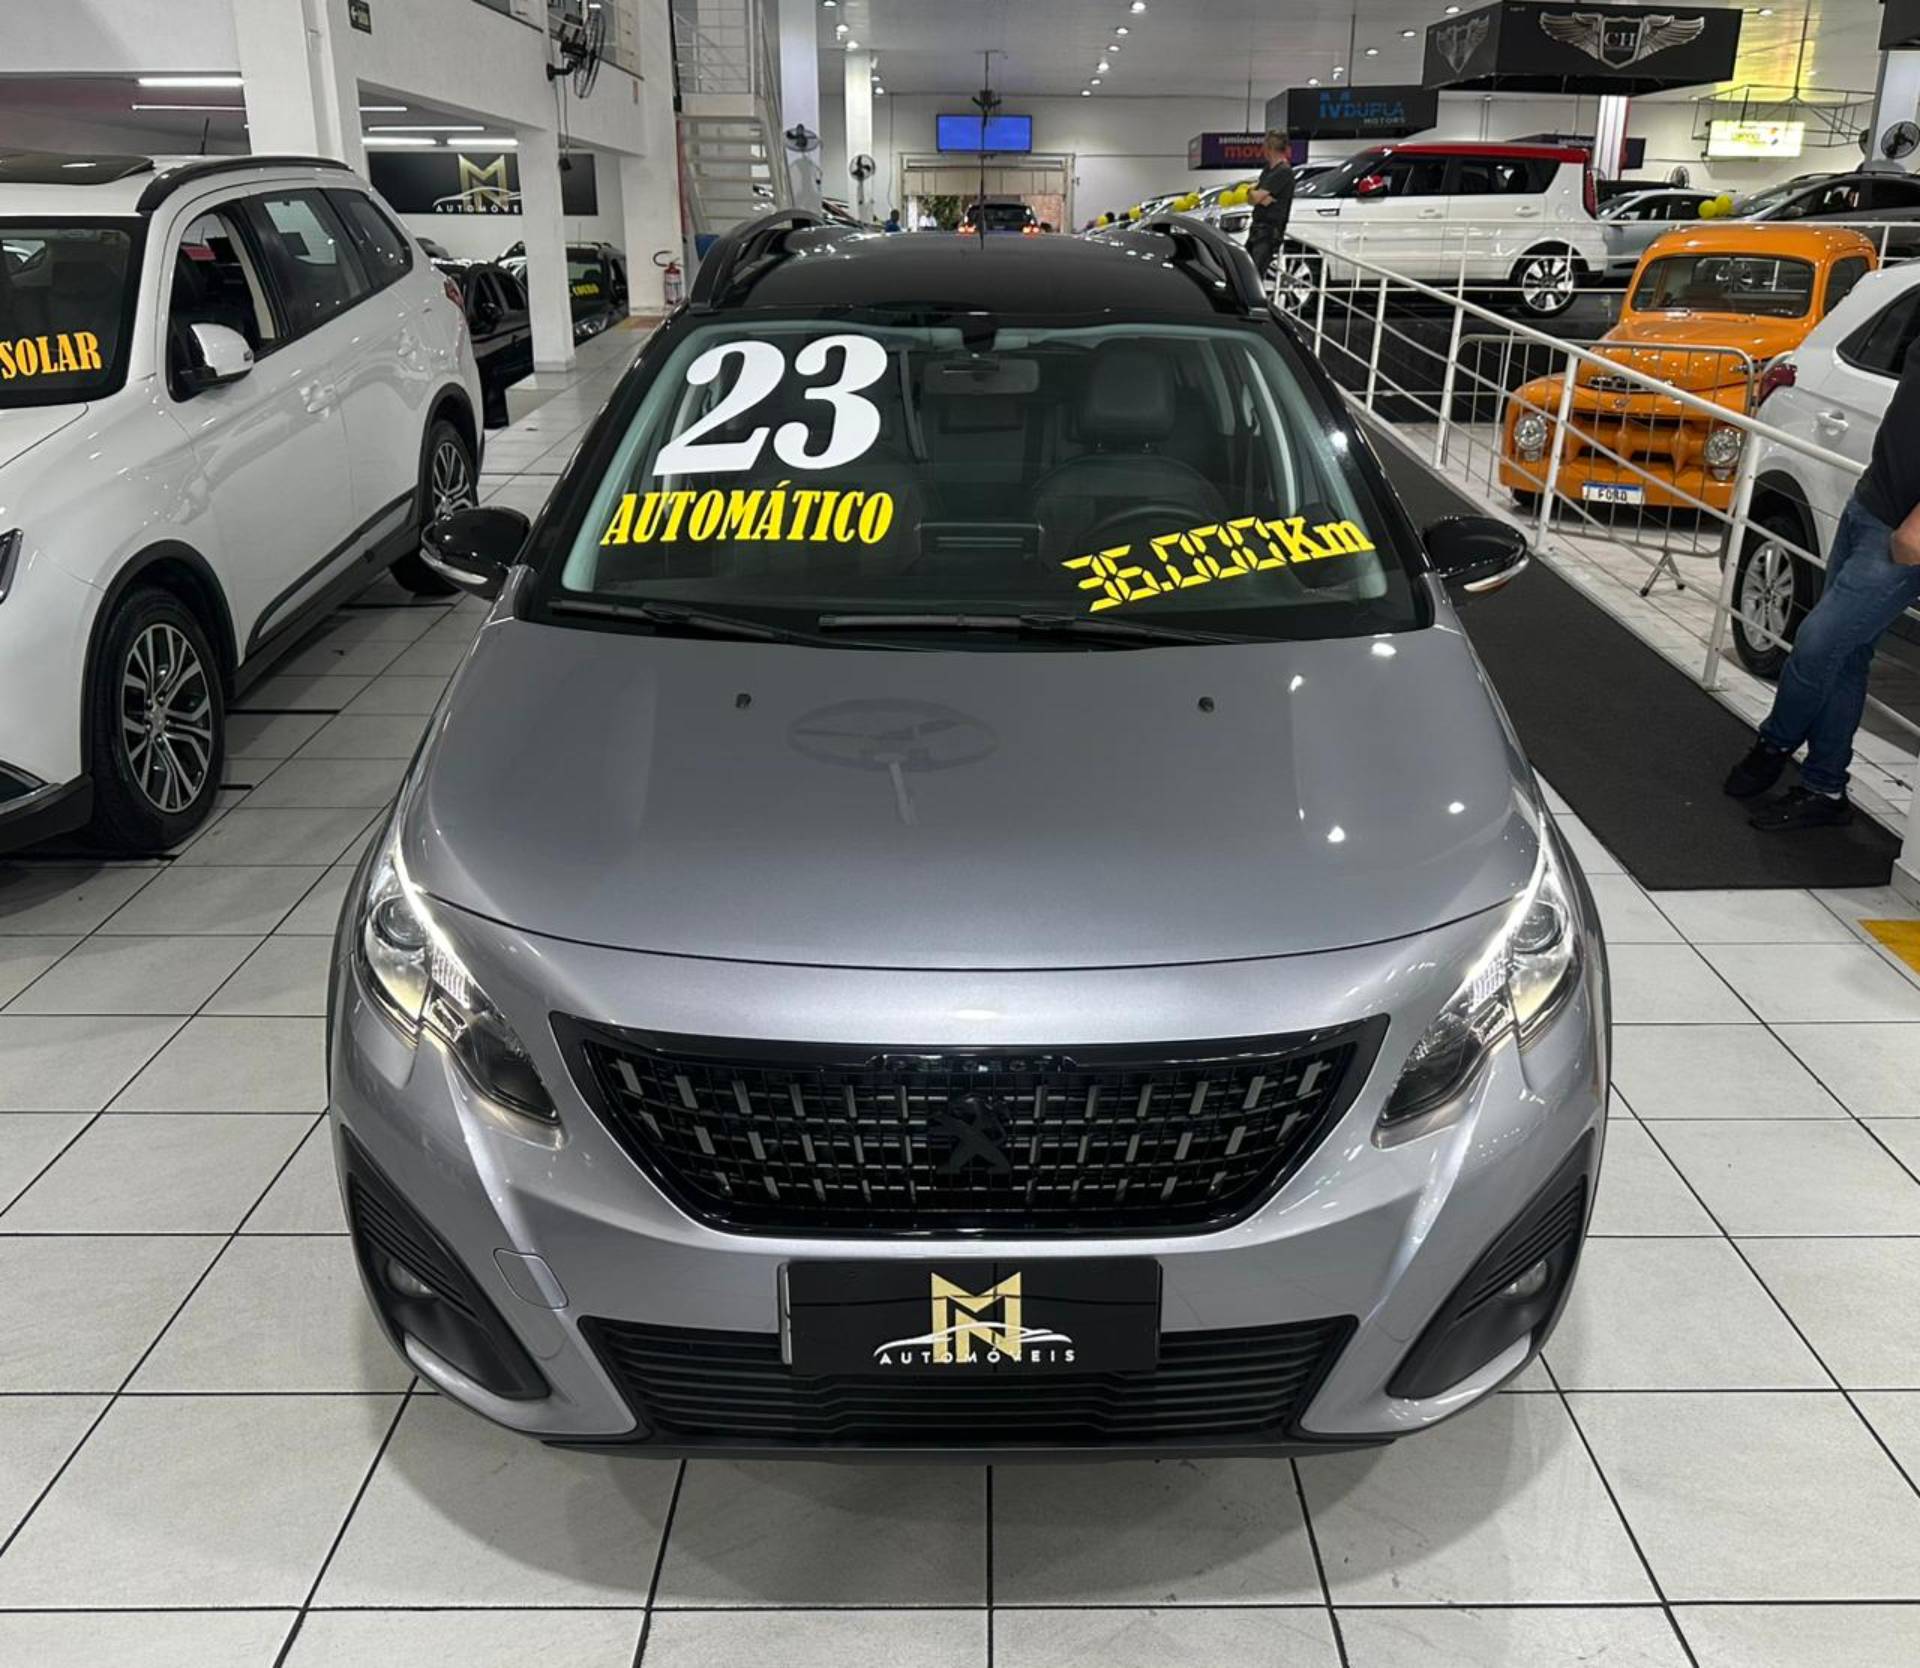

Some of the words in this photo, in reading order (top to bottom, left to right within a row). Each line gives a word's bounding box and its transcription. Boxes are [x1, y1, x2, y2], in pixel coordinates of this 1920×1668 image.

[1218, 135, 1265, 145] seminovo
[435, 202, 520, 213] AUTOMÓVE
[0, 331, 102, 380] SOLAR
[652, 334, 888, 476] 23
[599, 479, 894, 546] AUTOMÁTICO
